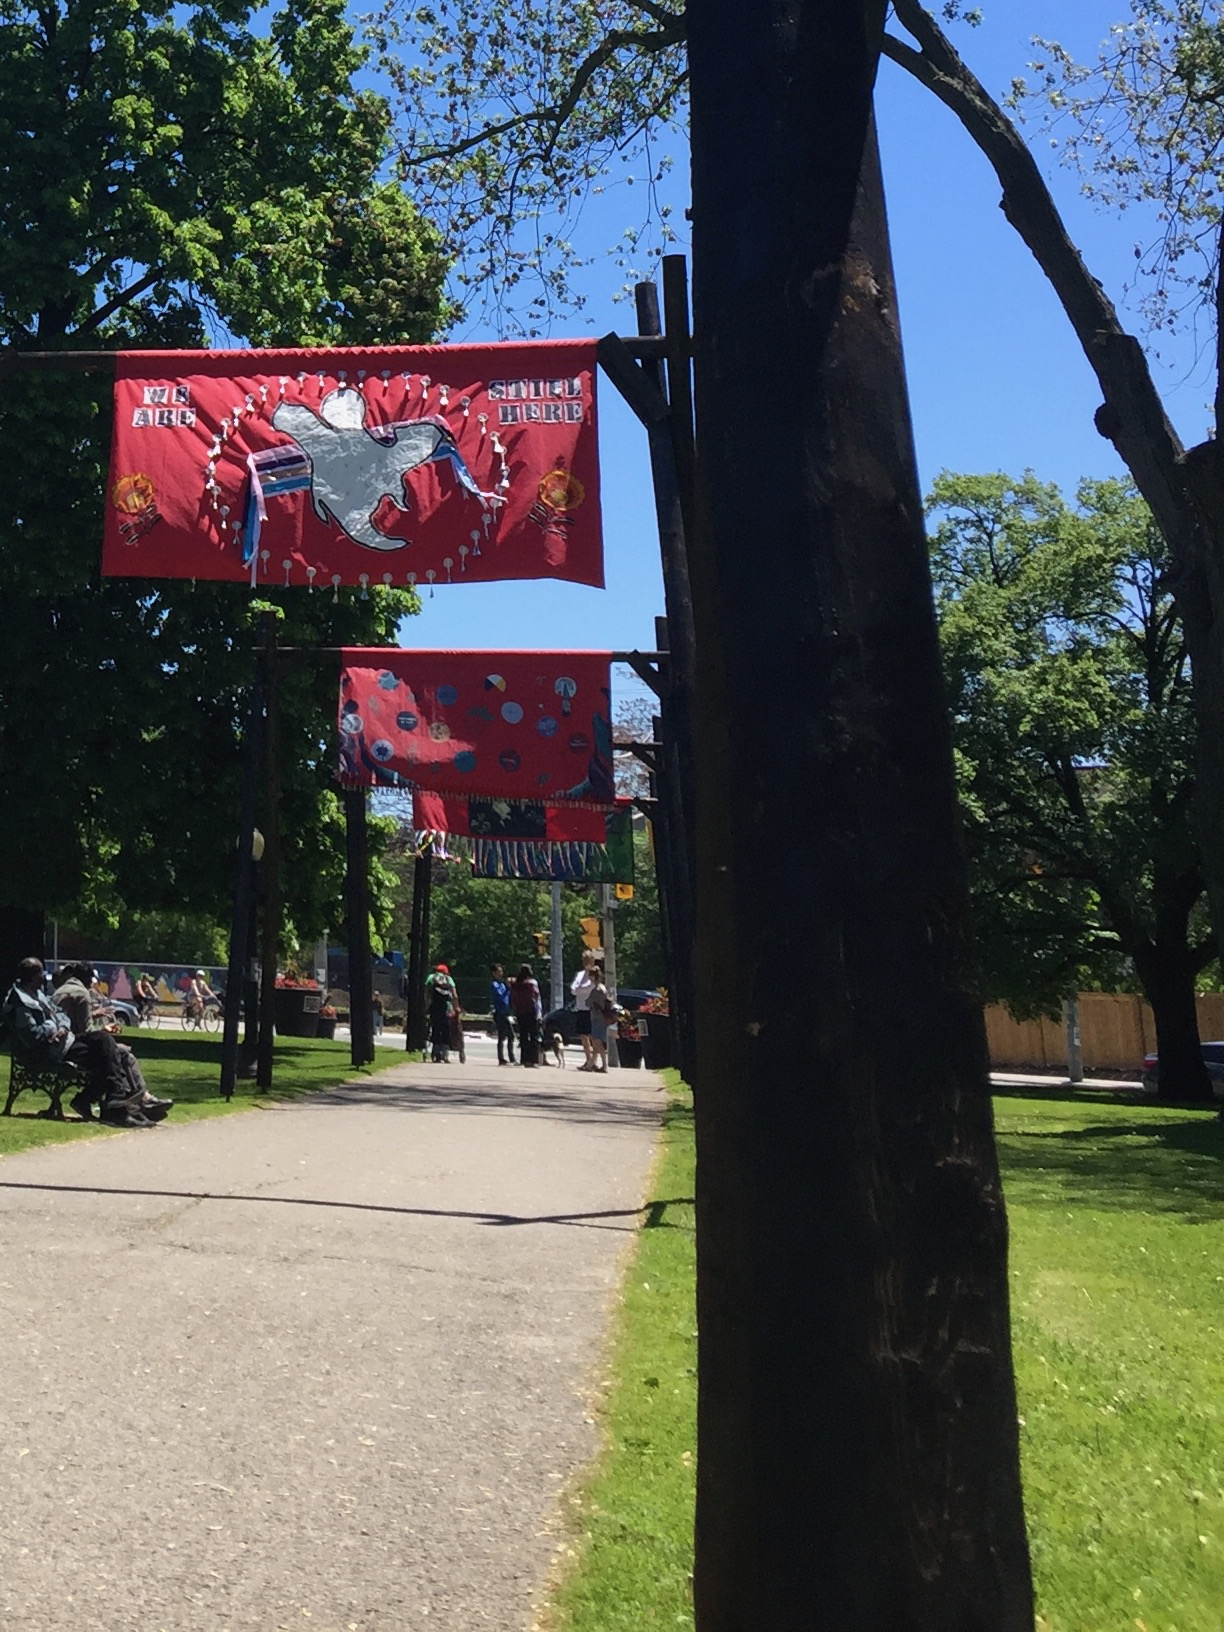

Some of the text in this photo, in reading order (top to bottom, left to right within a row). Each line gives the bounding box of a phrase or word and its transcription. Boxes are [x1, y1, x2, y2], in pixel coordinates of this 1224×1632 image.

[489, 378, 581, 399] STILL
[134, 408, 195, 427] ARE
[499, 402, 582, 424] HERE
